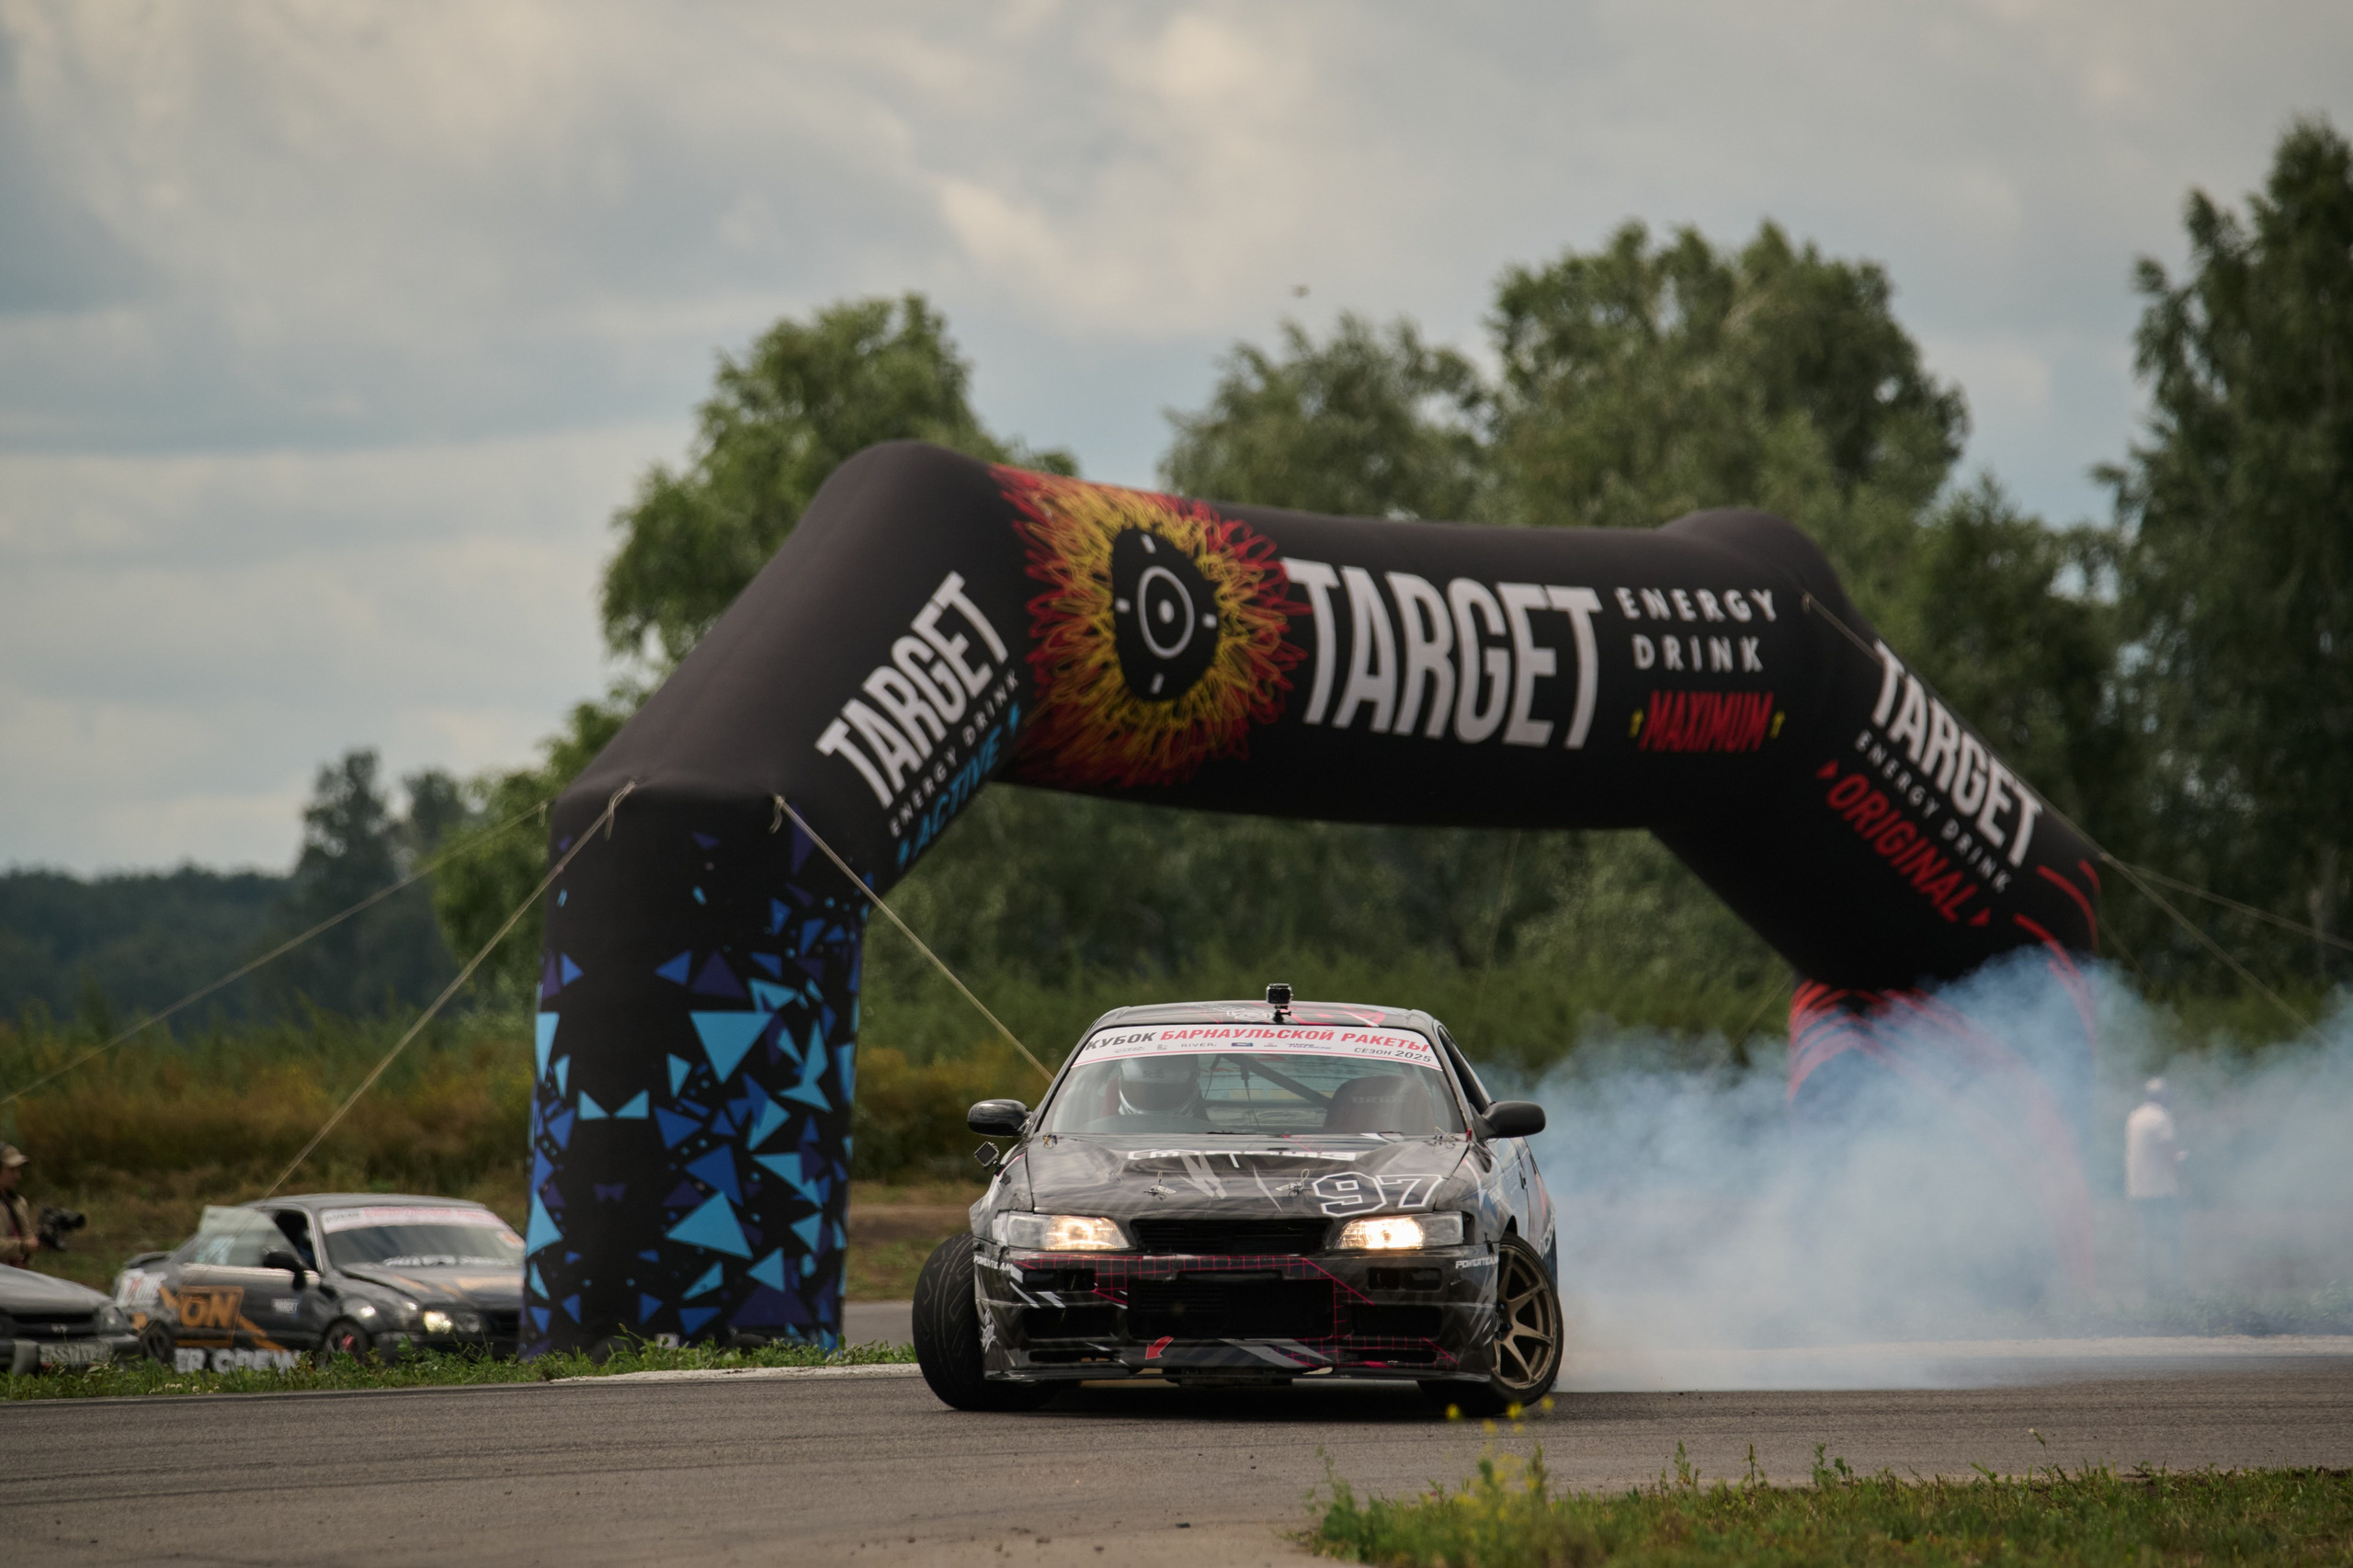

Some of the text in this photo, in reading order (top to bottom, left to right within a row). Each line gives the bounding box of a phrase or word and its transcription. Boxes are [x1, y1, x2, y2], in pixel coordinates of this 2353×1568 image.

[1282, 557, 1603, 749] TARGET
[1615, 587, 1778, 621] ENERGY
[1632, 635, 1764, 673] DRINK
[815, 571, 1008, 809] TARGET
[891, 671, 1018, 838] ENERGY DRINK
[1639, 690, 1775, 752] MAXIMUM
[1871, 638, 2043, 868] TARGET
[912, 724, 1003, 858] ACTIVE
[1826, 772, 1978, 923] ORIGINAL
[1855, 730, 2012, 893] ENERGY DRINK
[1085, 1028, 1429, 1052] КУБОК БАРНАУЛЬСКОЙ РАКЕТЫ
[1354, 1046, 1432, 1062] СЕЗОН 2025
[1311, 1171, 1448, 1218] 97
